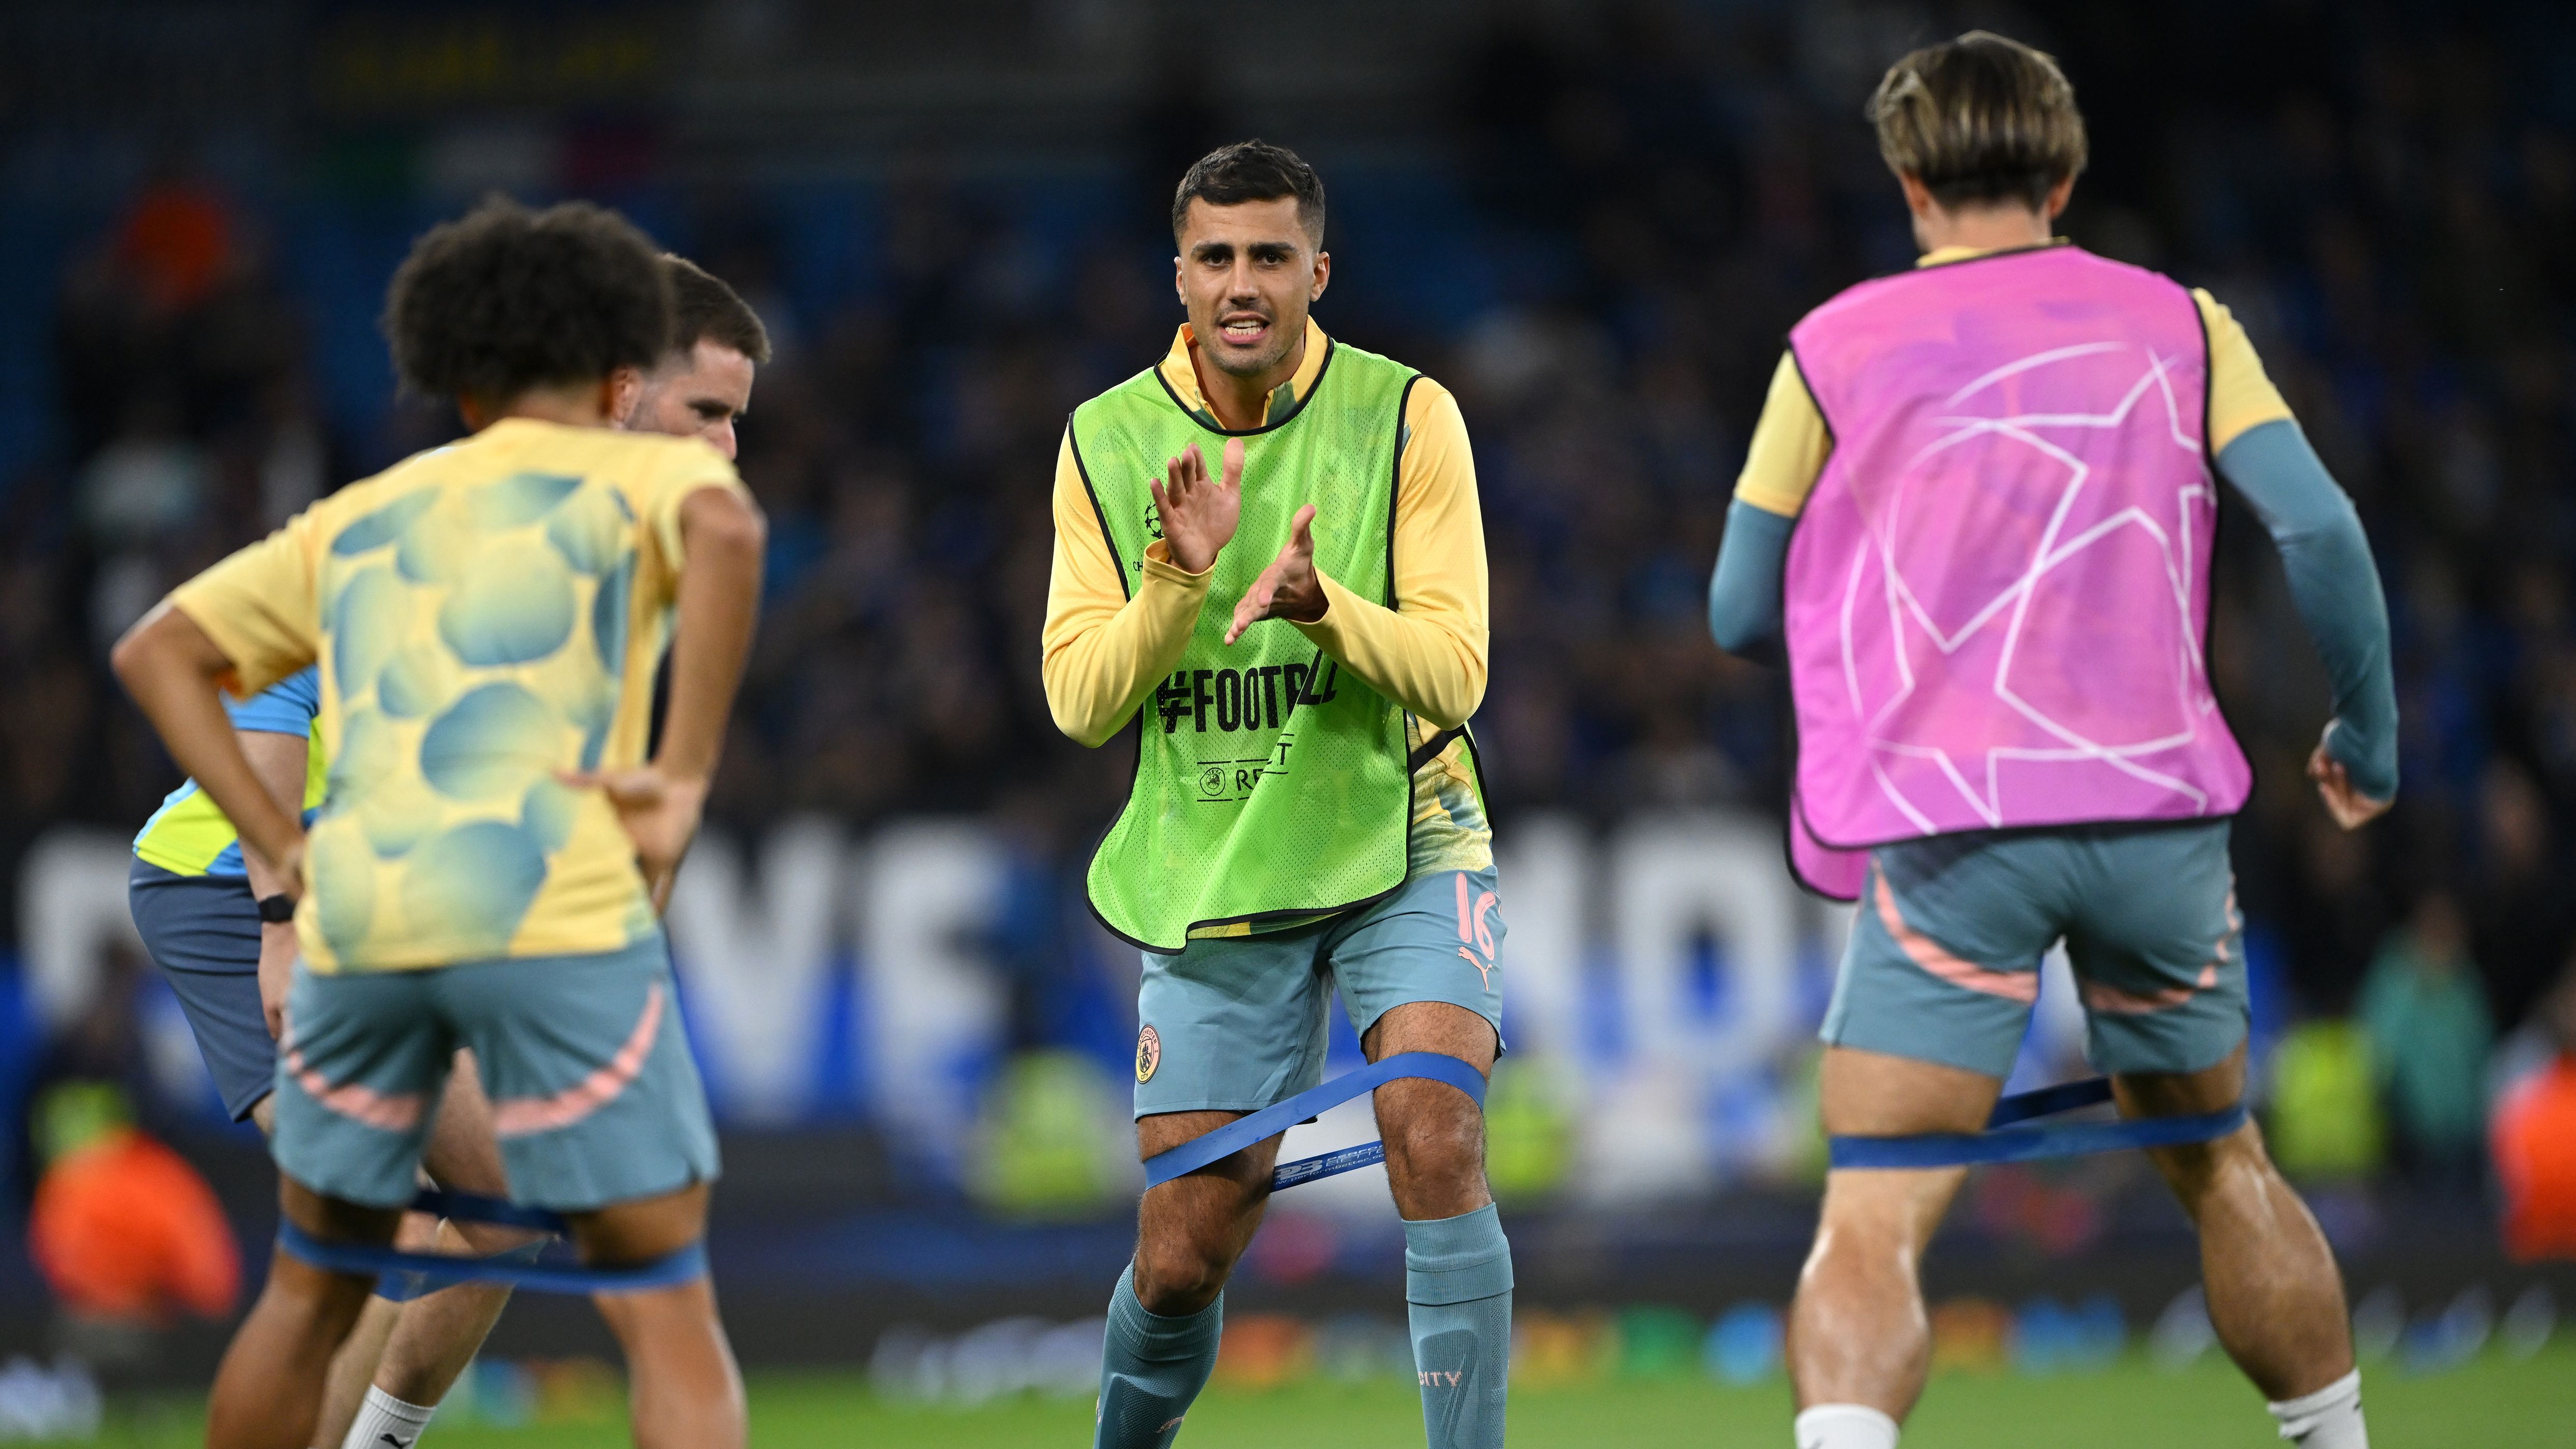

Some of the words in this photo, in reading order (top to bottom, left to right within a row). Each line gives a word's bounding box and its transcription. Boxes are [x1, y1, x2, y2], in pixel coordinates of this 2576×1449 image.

[1455, 872, 1496, 961] 16
[1326, 1147, 1384, 1167] BETTE
[1418, 1371, 1462, 1387] CITY
